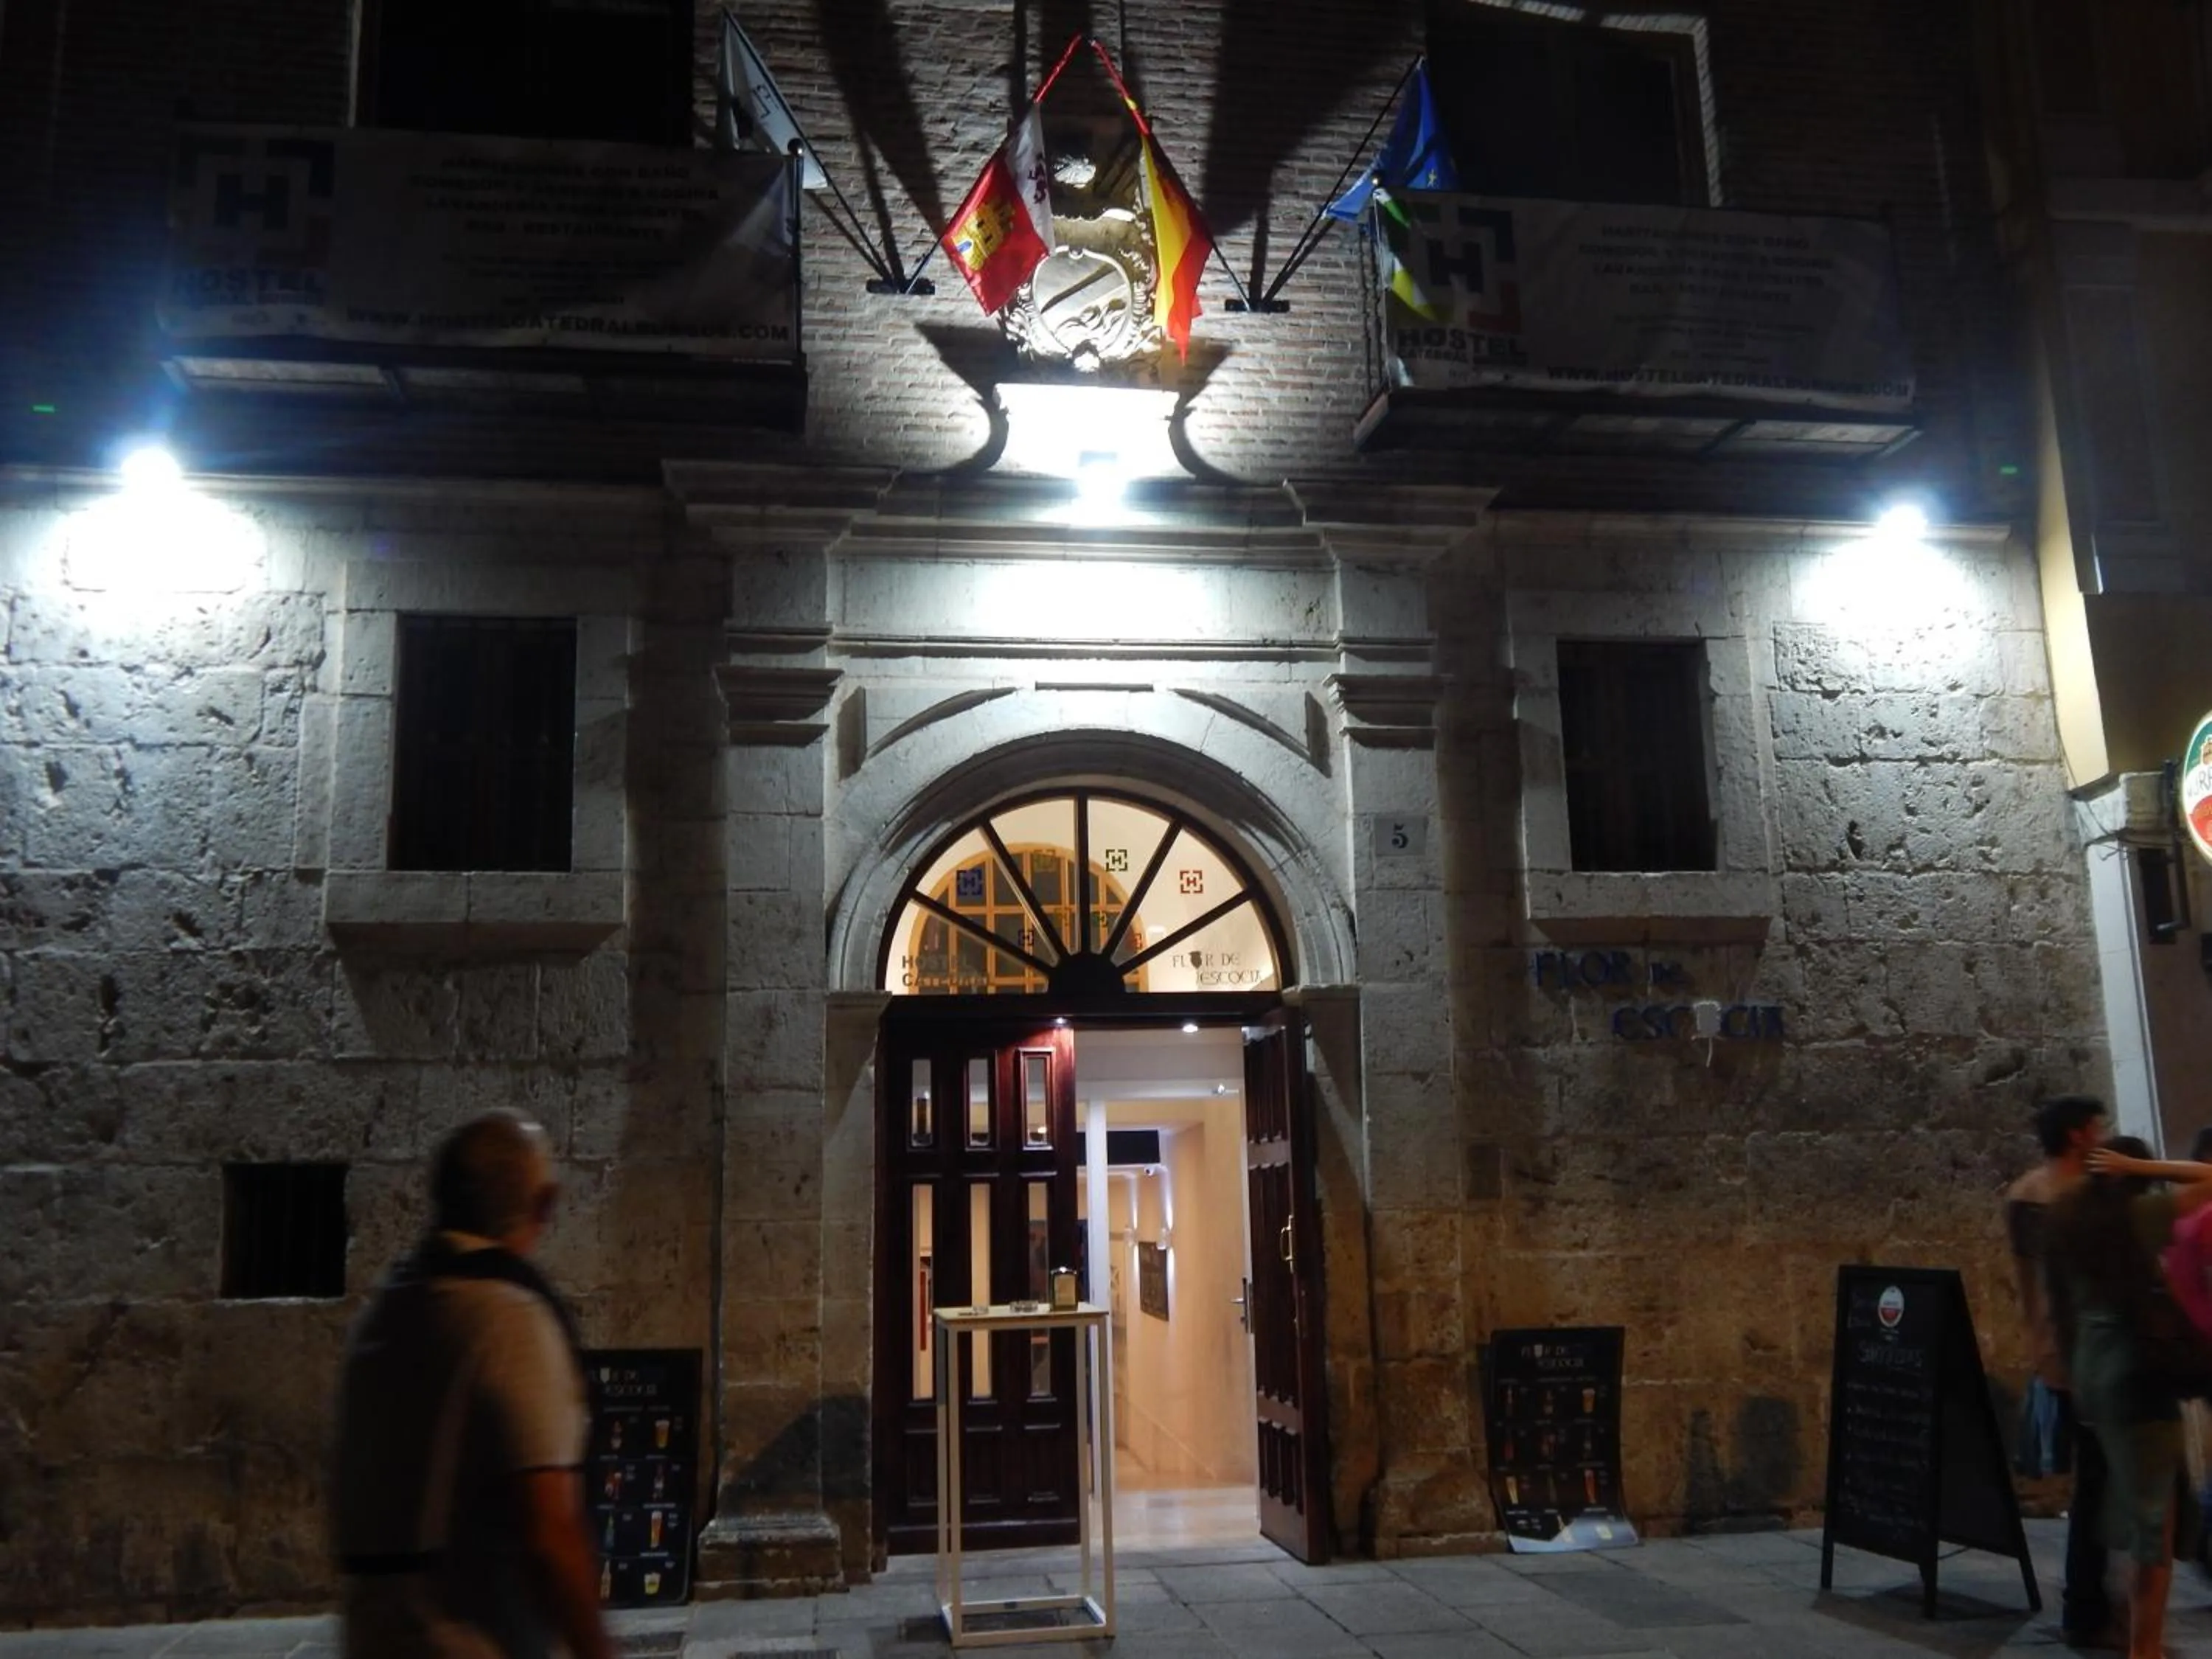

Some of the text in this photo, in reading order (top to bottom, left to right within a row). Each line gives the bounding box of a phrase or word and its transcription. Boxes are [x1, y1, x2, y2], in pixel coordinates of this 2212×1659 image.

[1391, 822, 1409, 849] 5
[1172, 951, 1214, 970] FLR
[1613, 1002, 1784, 1040] ESCCIA
